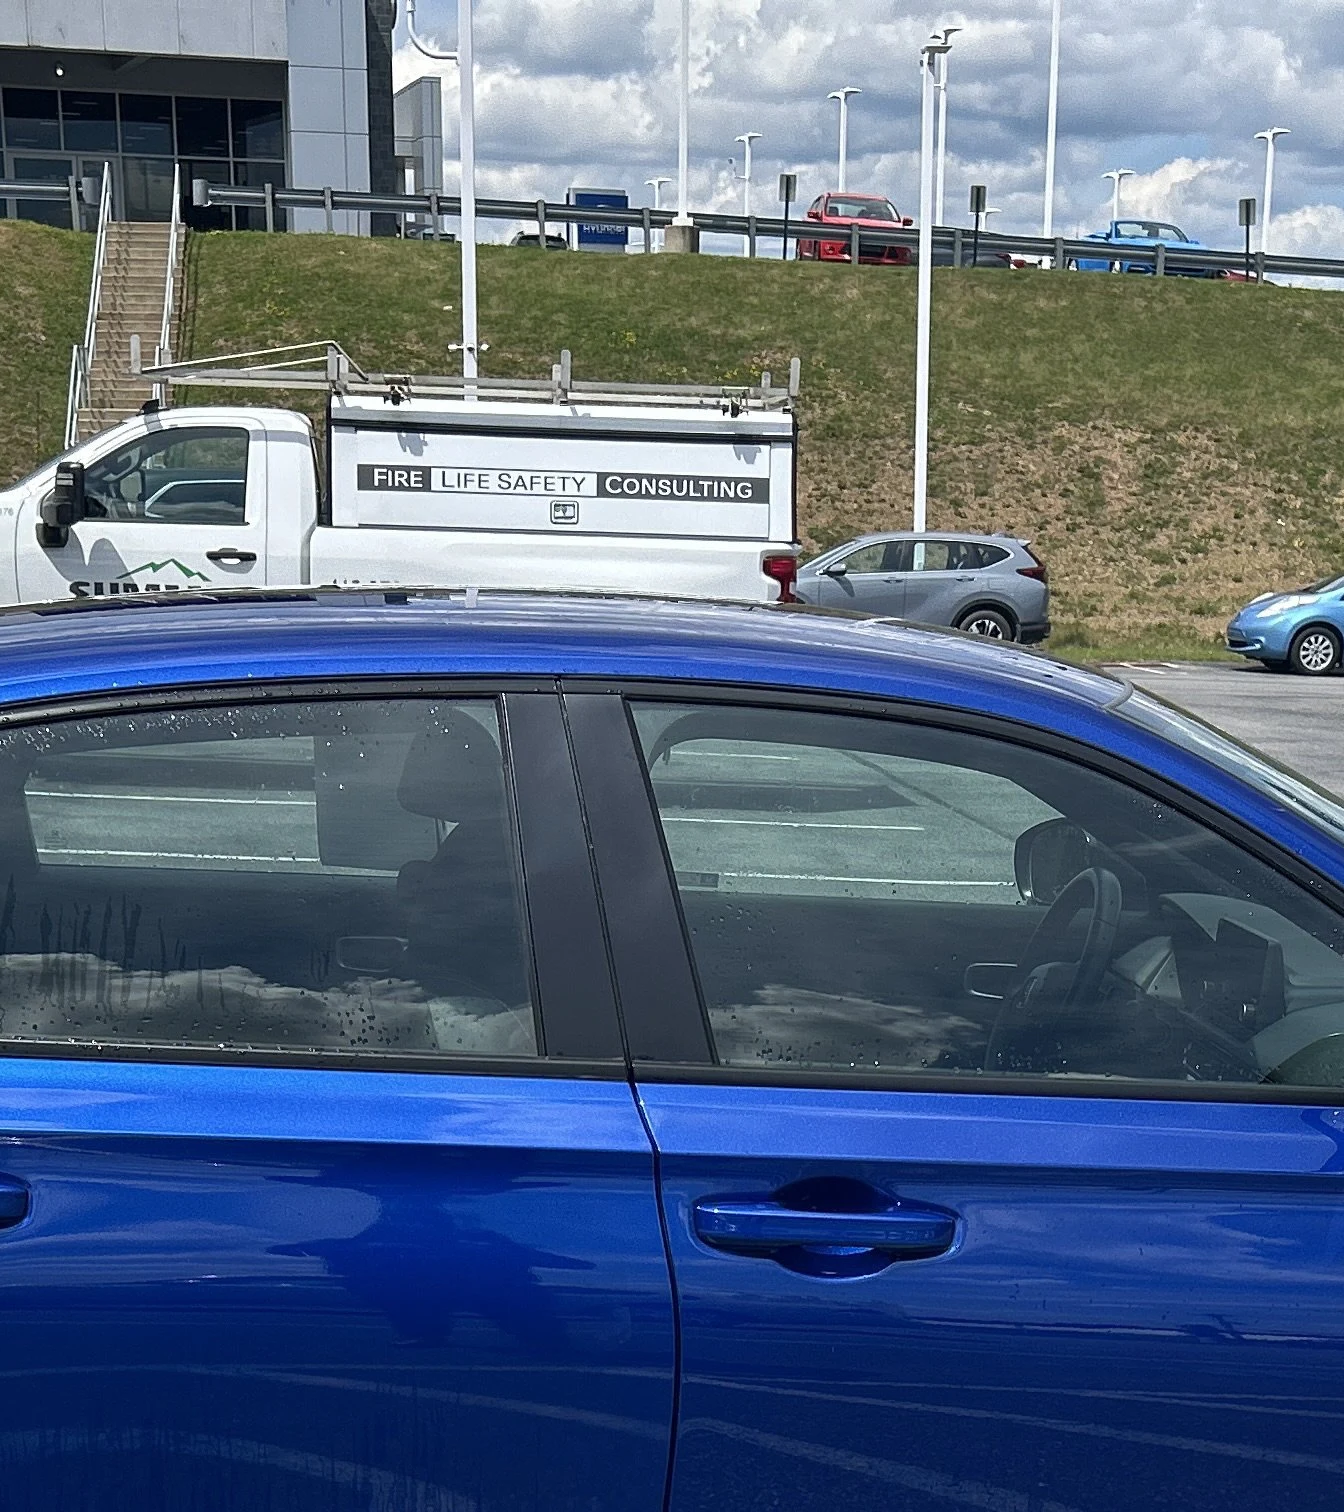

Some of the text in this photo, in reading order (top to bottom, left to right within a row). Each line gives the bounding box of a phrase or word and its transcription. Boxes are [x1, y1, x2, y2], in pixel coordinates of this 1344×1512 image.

[373, 468, 754, 499] FIRE LIFE SAFETY CONSULTING
